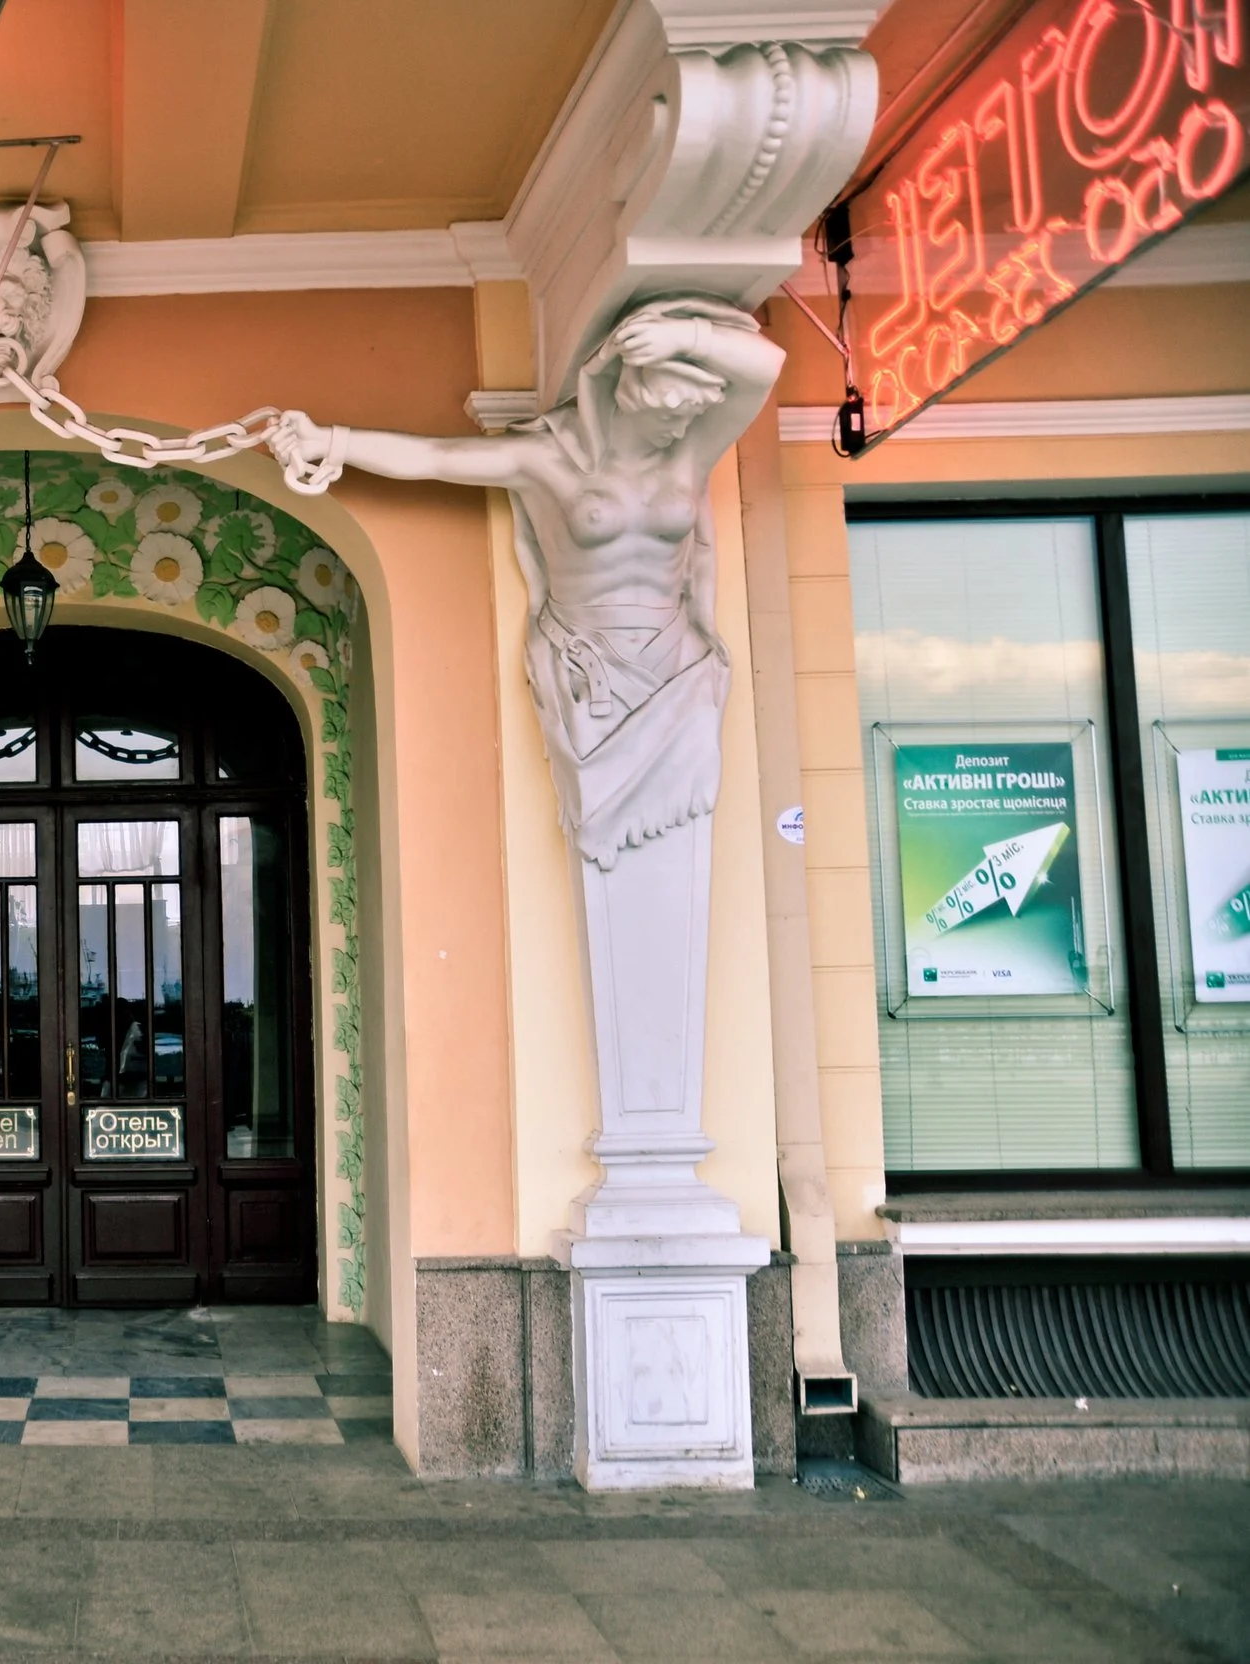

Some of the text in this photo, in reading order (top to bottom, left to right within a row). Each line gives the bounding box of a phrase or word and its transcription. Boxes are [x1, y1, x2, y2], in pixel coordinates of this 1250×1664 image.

[955, 754, 1010, 769] Депозит
[903, 772, 1066, 790] «АКТИВНІ ГРОШІ»
[903, 795, 1067, 812] Ставка зростає щомісяця
[1190, 788, 1250, 805] «АКТИ
[1190, 811, 1236, 825] Ставка
[991, 969, 1013, 978] VISA
[99, 1112, 169, 1132] Отель
[95, 1132, 174, 1153] открыт
